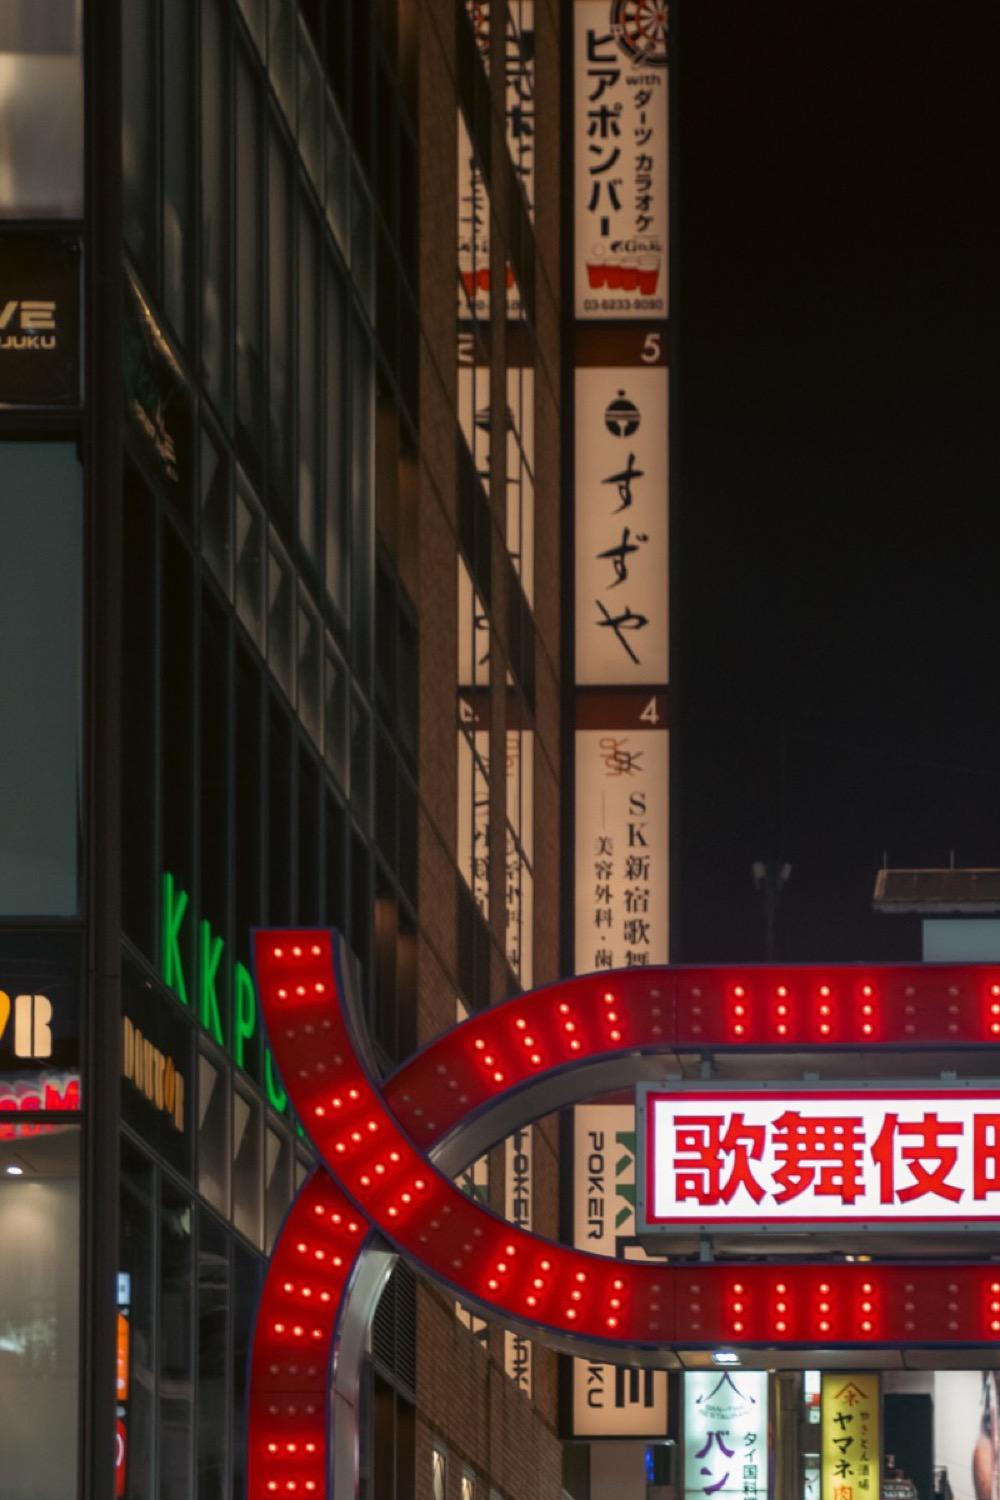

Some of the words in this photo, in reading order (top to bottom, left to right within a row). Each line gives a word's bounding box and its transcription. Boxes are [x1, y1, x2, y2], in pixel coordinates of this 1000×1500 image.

[641, 333, 661, 362] 5
[597, 453, 650, 665] すずや
[640, 696, 659, 724] 4
[588, 1132, 604, 1240] POKER
